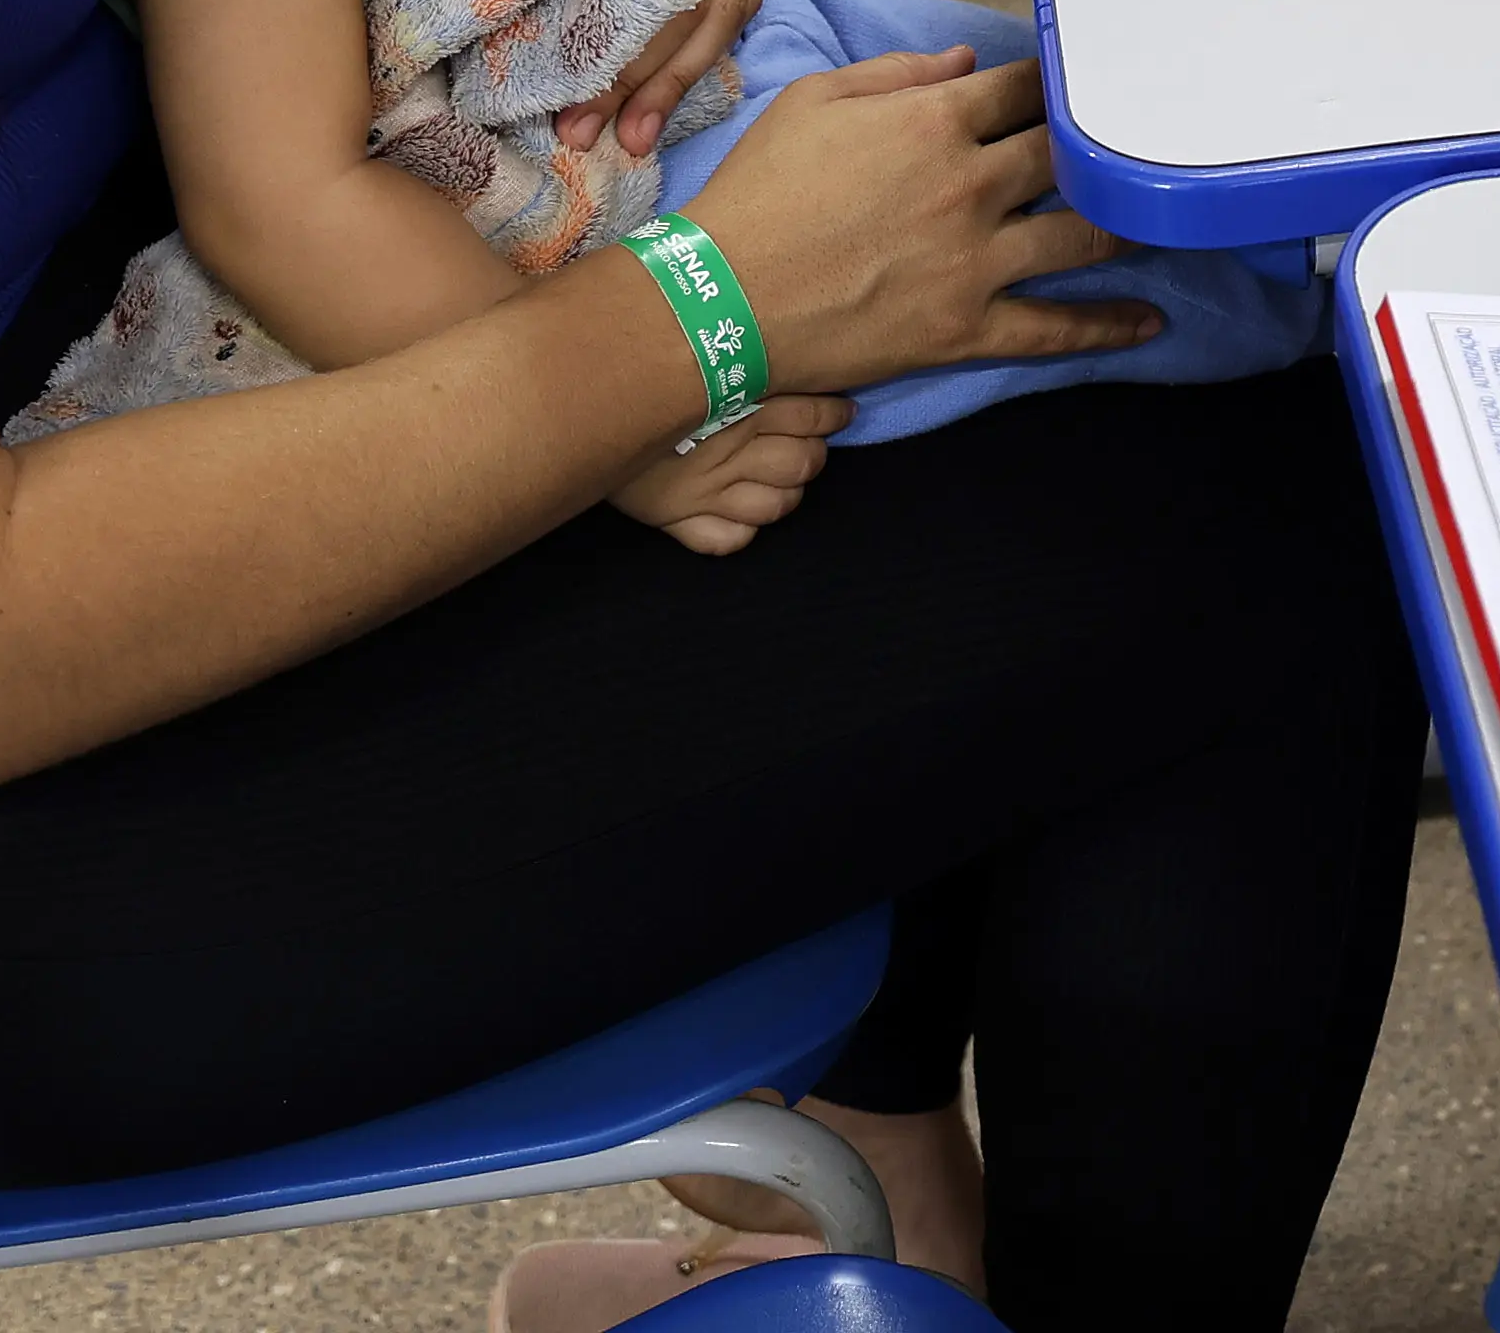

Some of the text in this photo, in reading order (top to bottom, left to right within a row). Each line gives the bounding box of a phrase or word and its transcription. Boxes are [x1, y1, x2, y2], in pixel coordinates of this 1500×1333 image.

[649, 240, 693, 297] Mato Grosso
[662, 232, 720, 303] SENAR
[696, 328, 718, 367] FAMATO
[716, 367, 730, 397] SENAR
